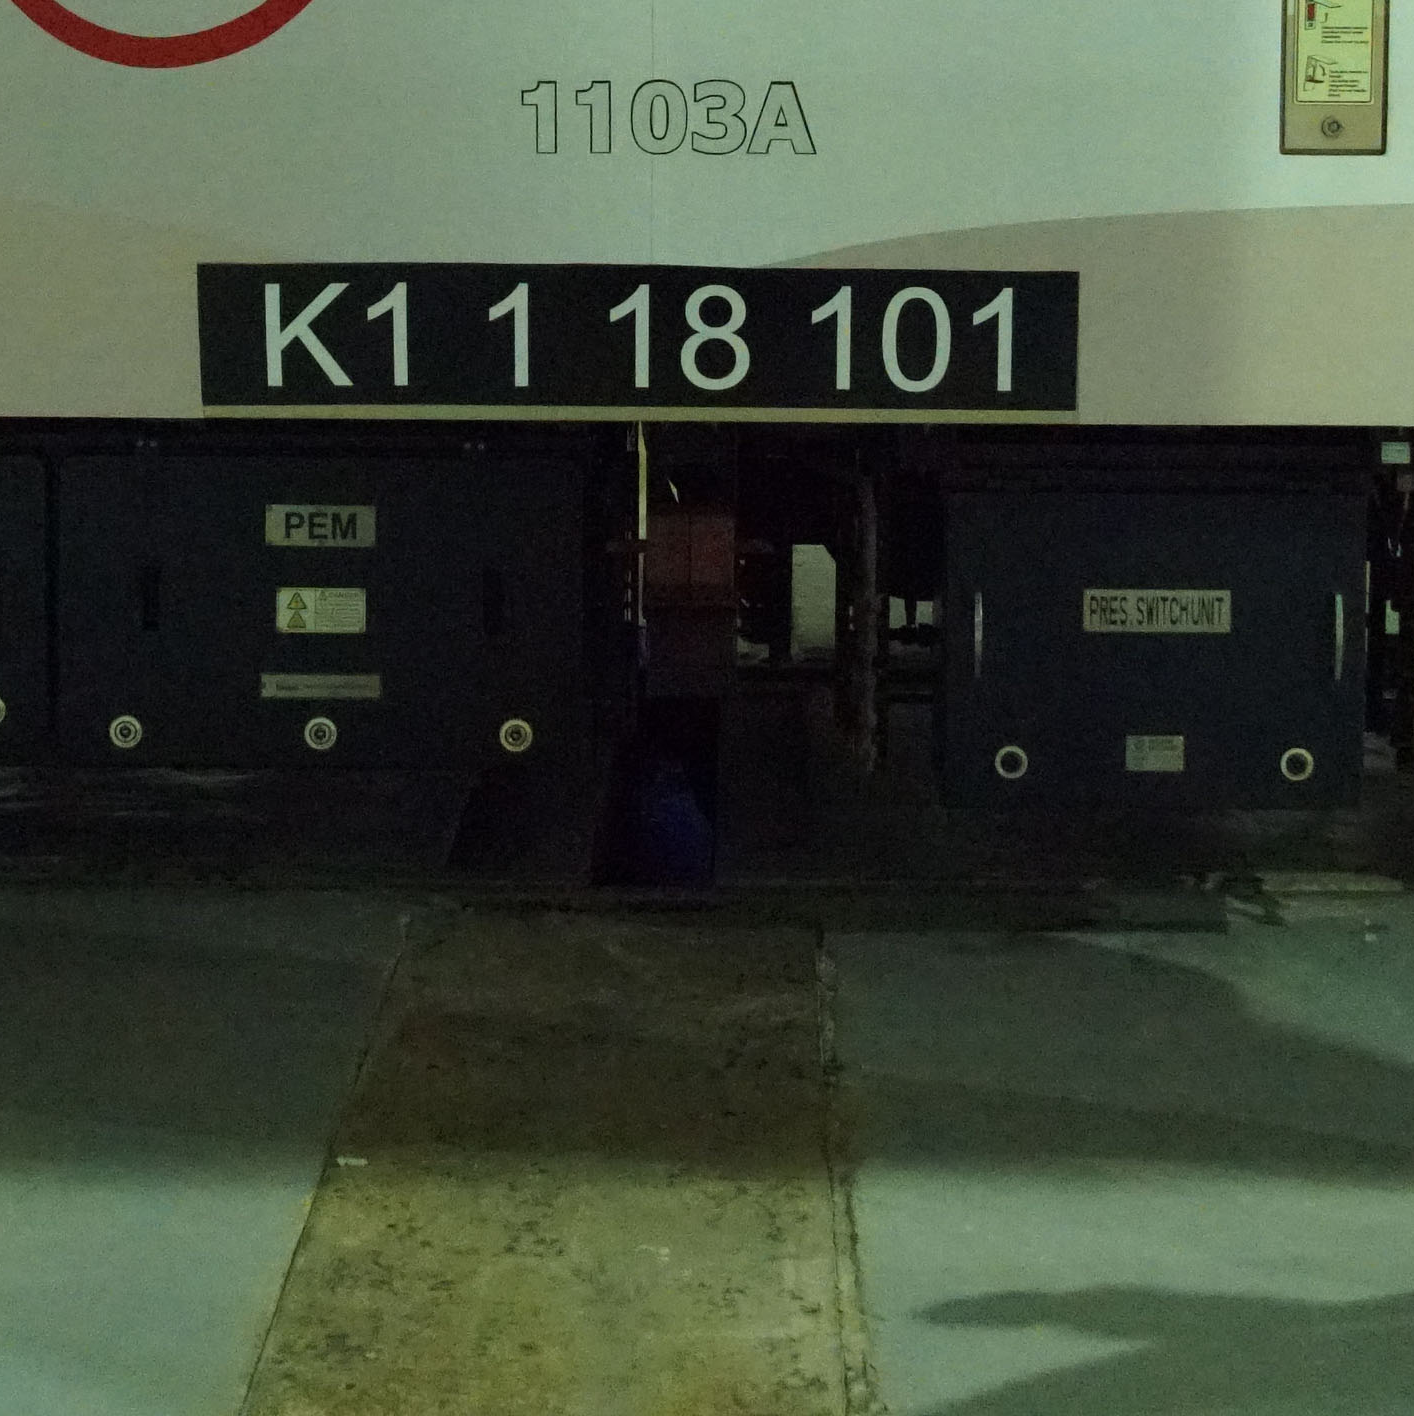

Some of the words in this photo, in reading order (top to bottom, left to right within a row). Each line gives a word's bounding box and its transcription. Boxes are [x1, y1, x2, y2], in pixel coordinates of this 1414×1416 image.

[520, 78, 817, 156] 1103A
[264, 281, 409, 388] K1
[488, 282, 529, 388] 1
[609, 283, 751, 391] 18
[811, 285, 1014, 393] 101
[284, 511, 358, 541] PEM
